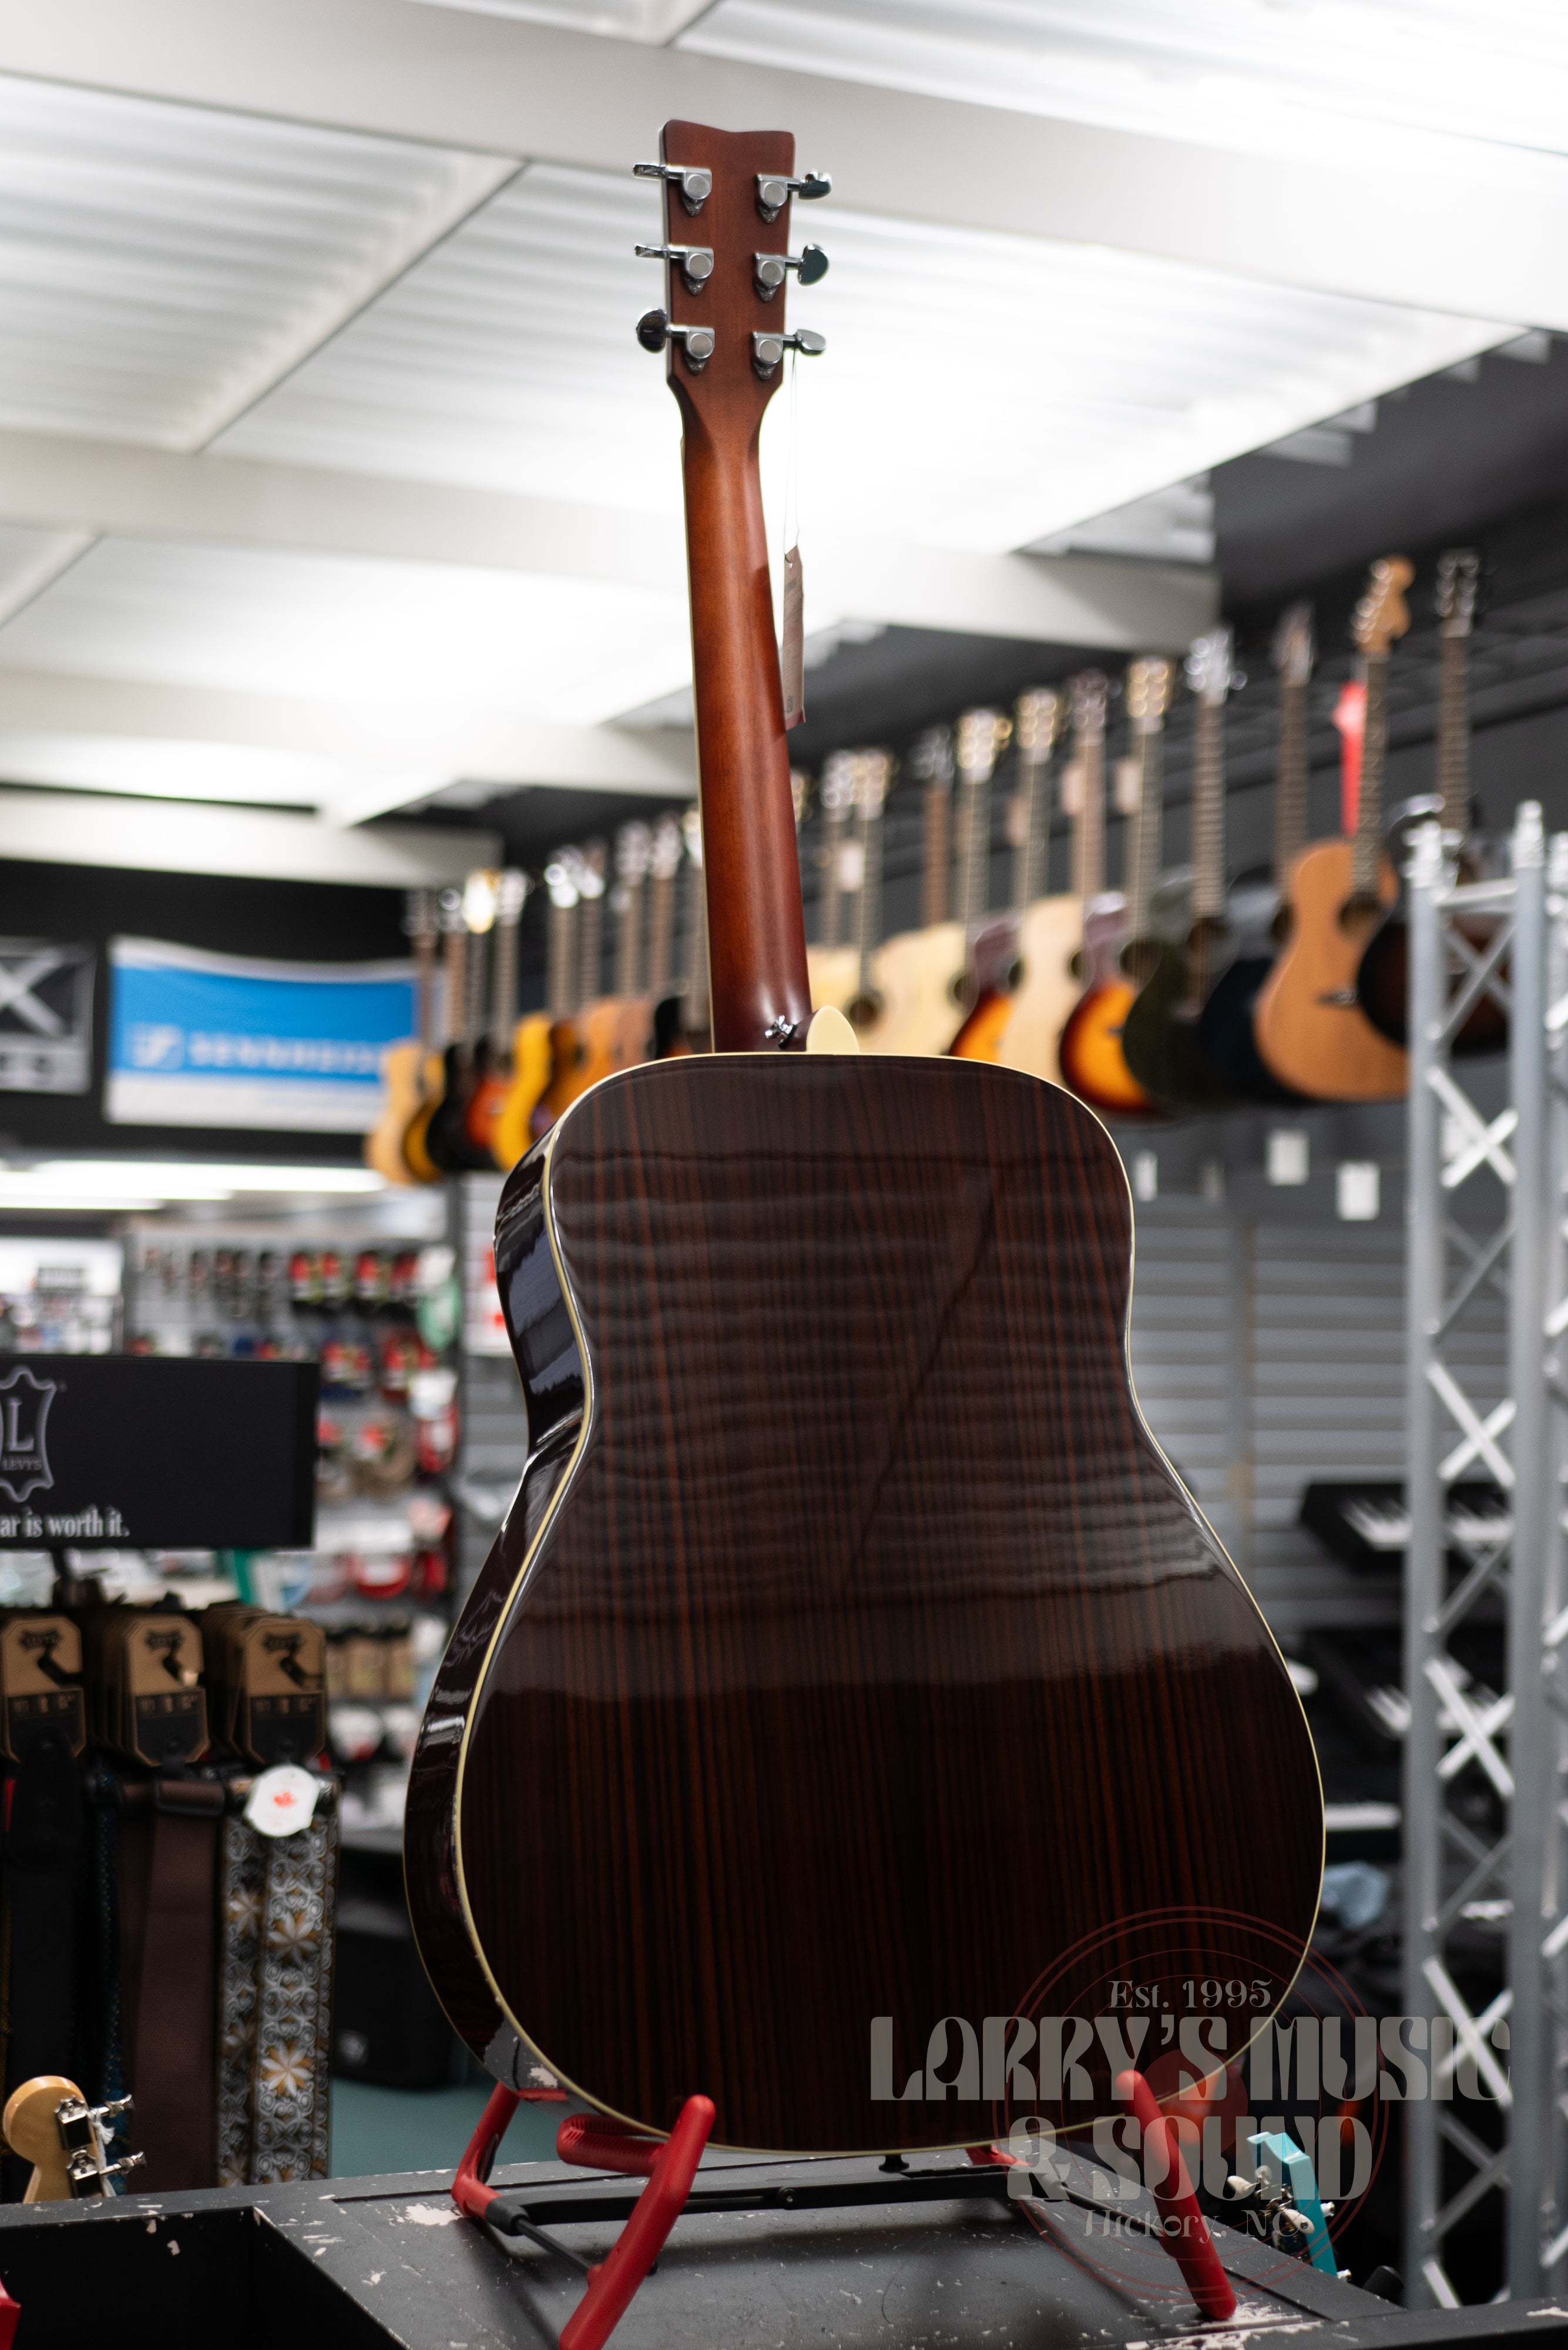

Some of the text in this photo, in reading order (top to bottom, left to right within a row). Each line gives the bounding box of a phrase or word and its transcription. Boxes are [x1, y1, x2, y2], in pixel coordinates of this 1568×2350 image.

[24, 1508, 43, 1537] is
[48, 1505, 103, 1537] worth
[108, 1506, 130, 1537] it.
